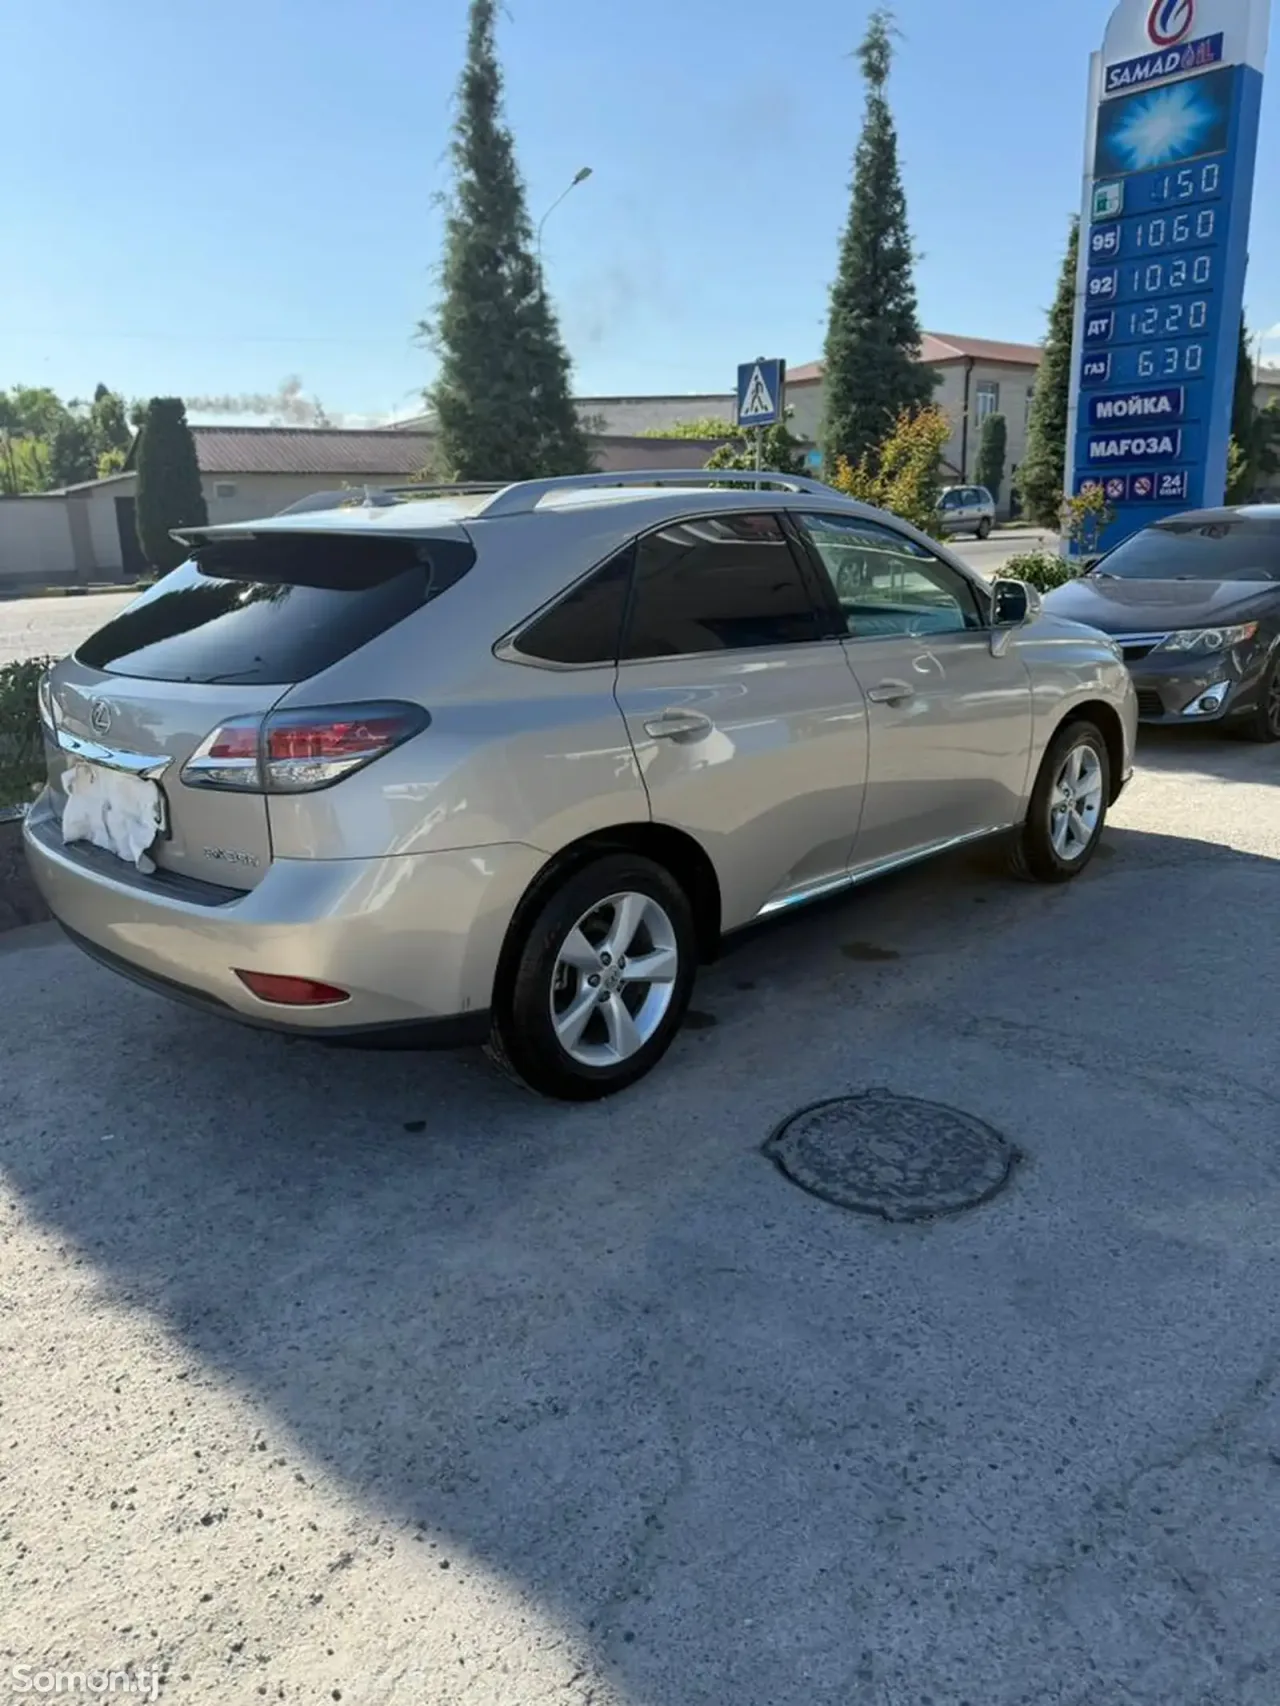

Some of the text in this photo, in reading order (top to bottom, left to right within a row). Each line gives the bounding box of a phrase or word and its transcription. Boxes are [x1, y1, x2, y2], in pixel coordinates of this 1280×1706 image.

[1092, 232, 1116, 251] 95
[1089, 276, 1112, 295] 92
[1087, 319, 1109, 336] ДТ
[1084, 362, 1105, 376] ГАЗ
[1096, 395, 1172, 418] МОЙКА
[1162, 475, 1180, 487] 24
